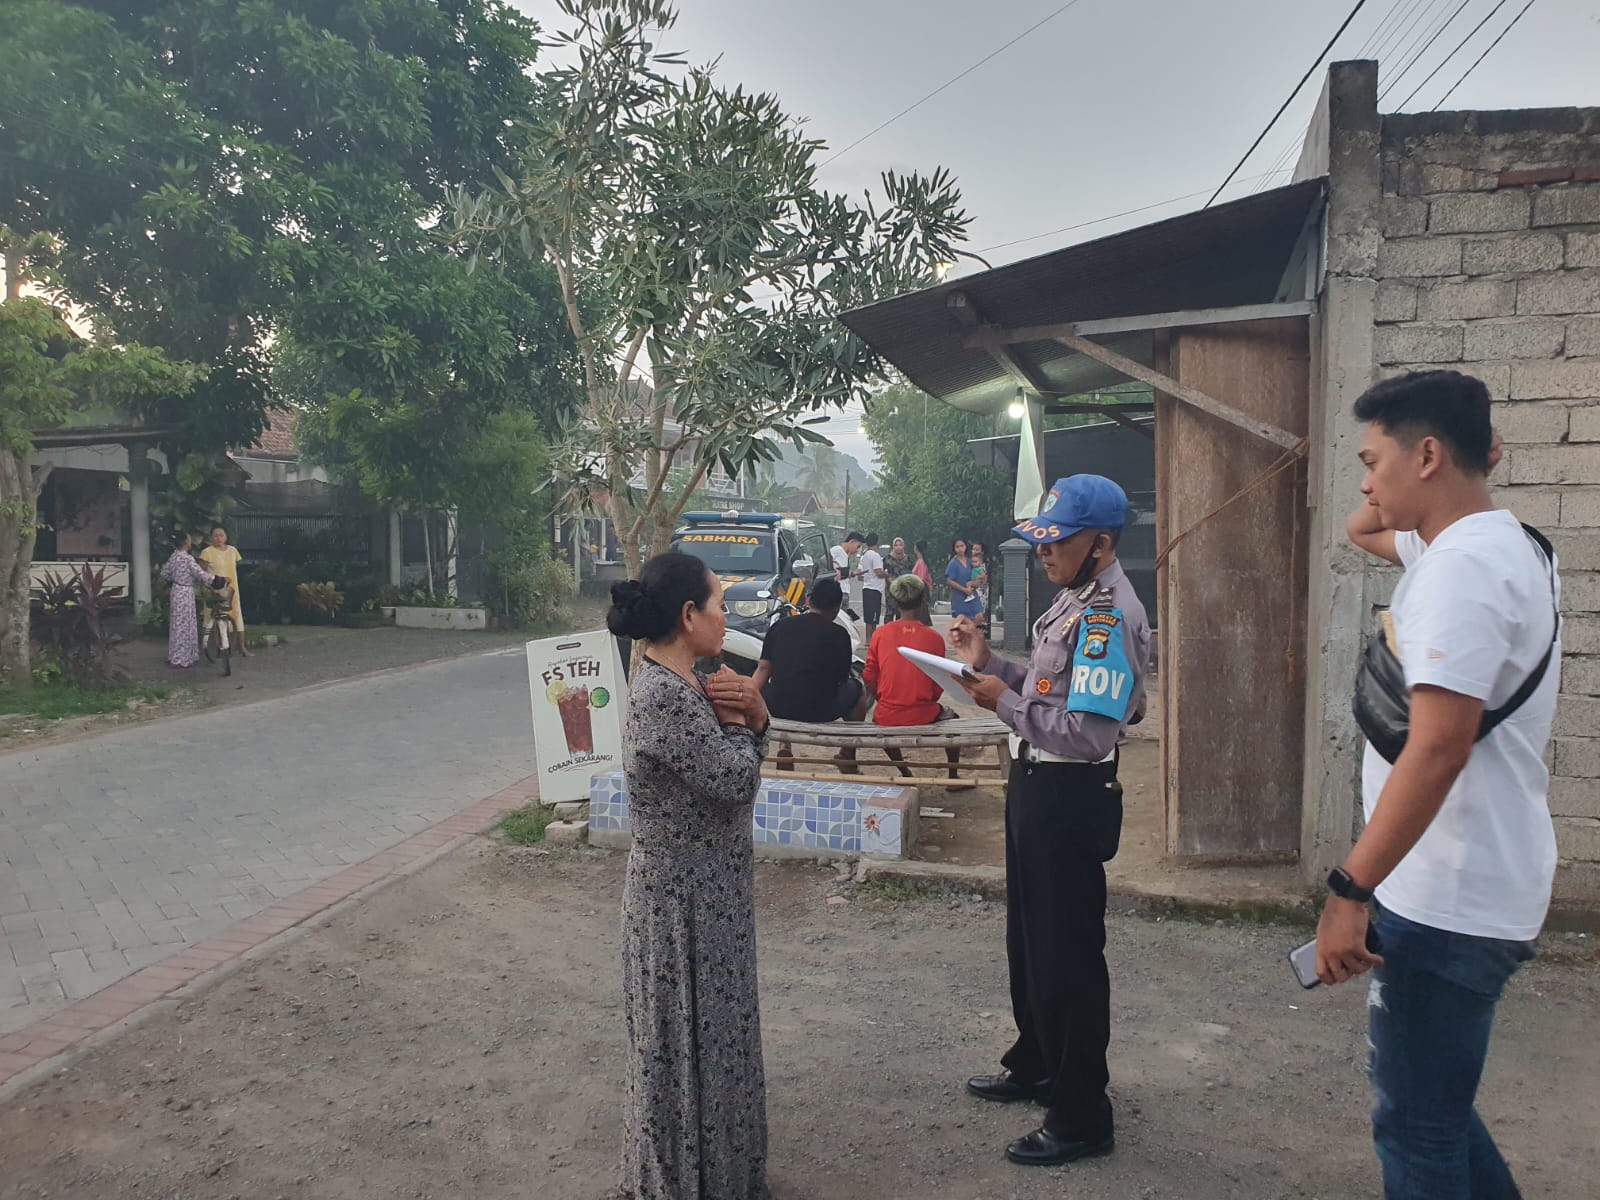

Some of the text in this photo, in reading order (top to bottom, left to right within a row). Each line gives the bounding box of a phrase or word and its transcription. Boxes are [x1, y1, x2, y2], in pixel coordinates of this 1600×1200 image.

[682, 535, 760, 545] SABHARA
[567, 660, 600, 678] TEH
[548, 754, 613, 773] COBAIN SEKARANG!
